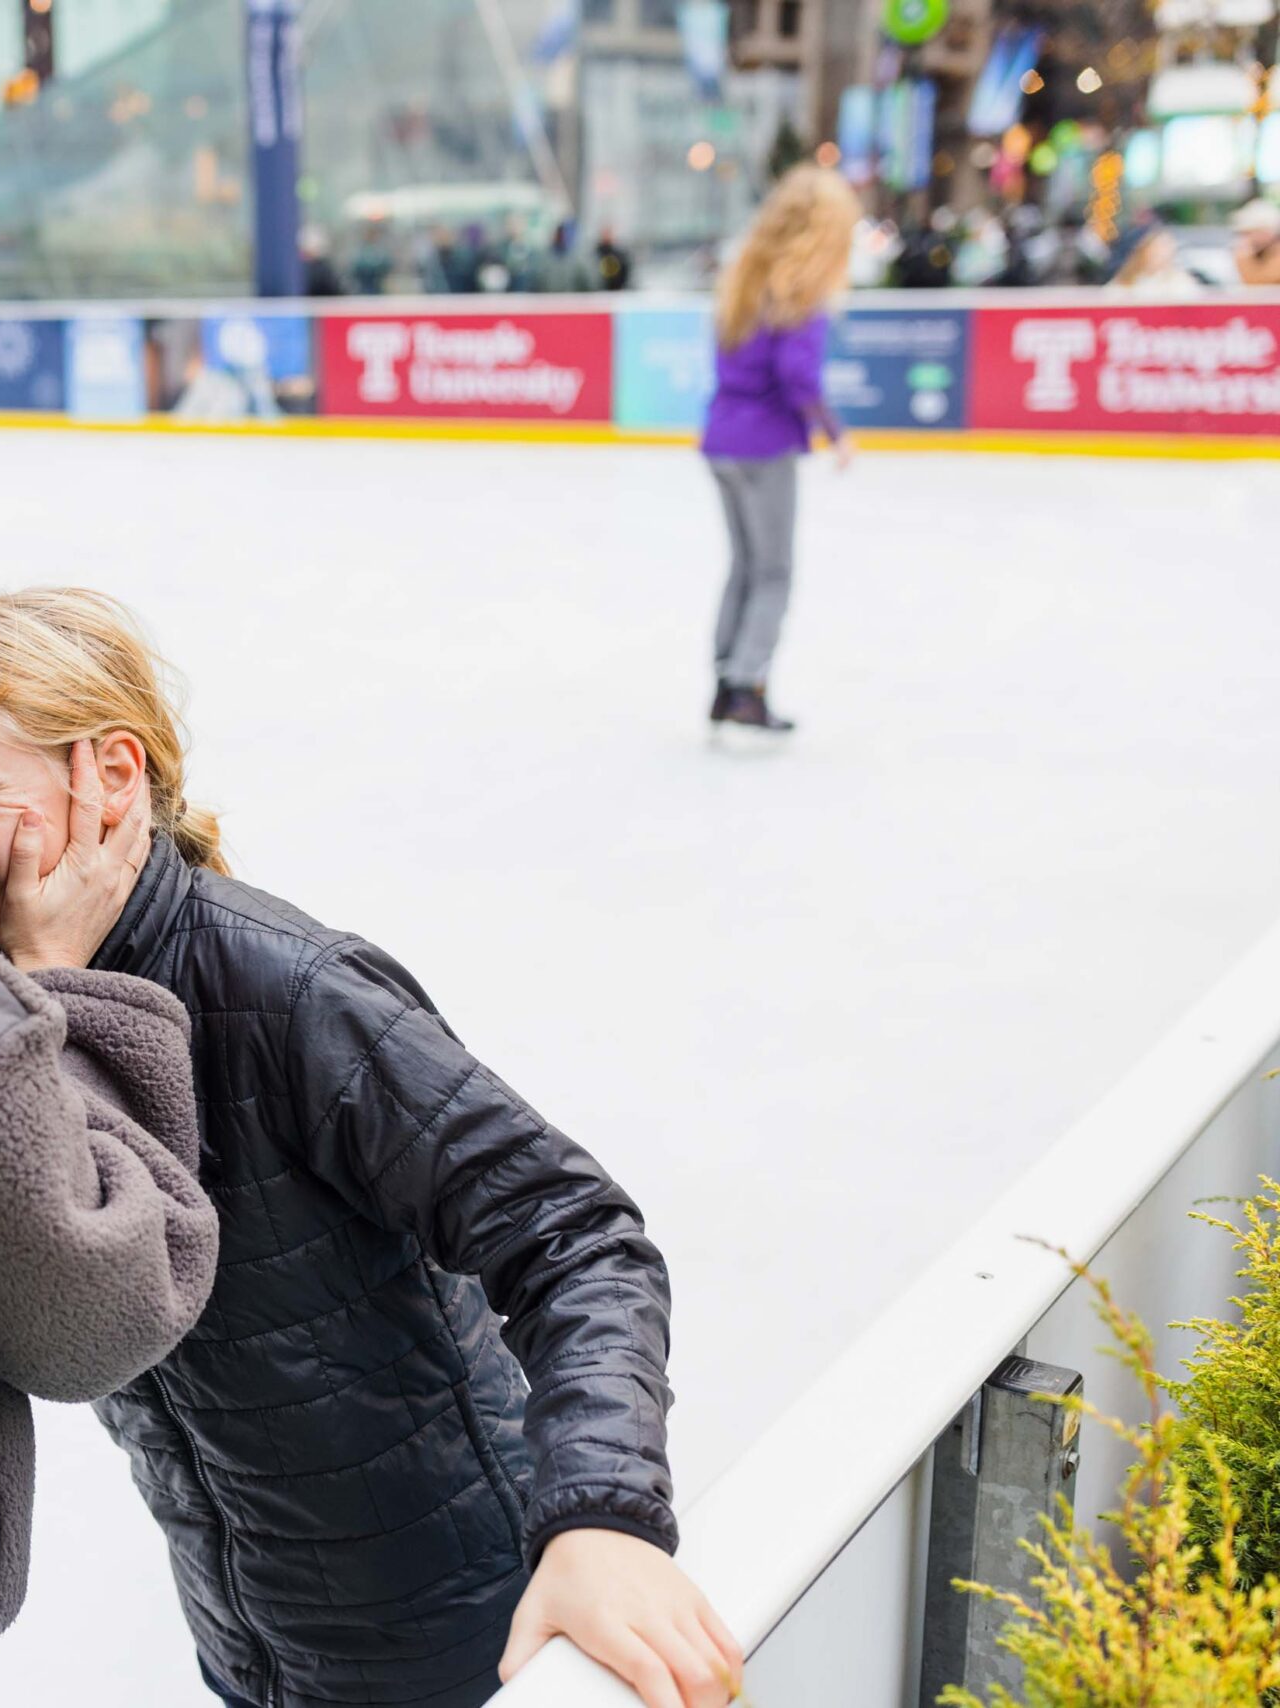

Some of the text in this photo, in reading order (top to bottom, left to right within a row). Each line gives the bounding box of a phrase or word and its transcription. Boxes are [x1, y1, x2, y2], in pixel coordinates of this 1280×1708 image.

[413, 321, 534, 366] Temple
[1101, 317, 1275, 373] Temple
[409, 362, 583, 414] University
